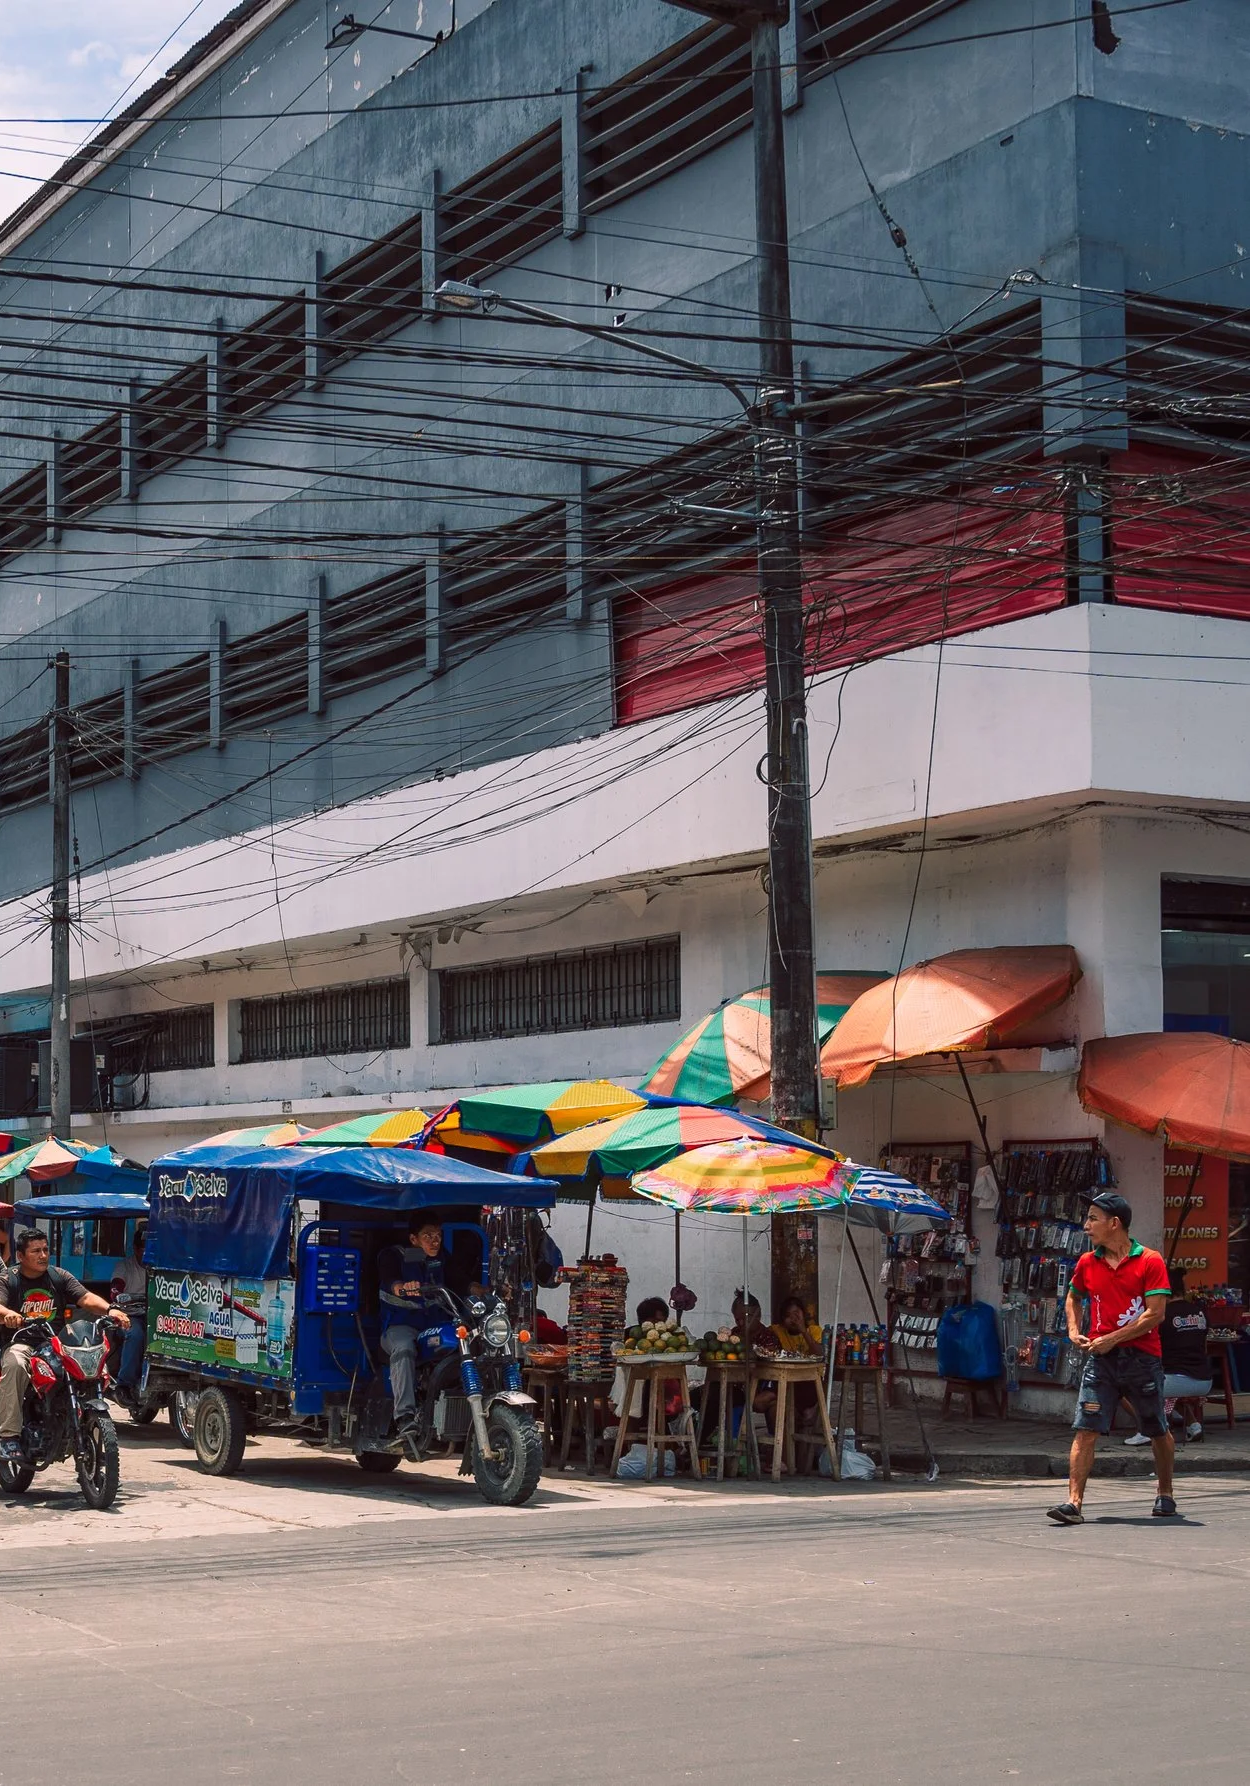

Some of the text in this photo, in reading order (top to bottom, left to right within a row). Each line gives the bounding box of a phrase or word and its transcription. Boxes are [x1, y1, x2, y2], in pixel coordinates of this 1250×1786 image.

[159, 1173, 227, 1197] Yacu Selva
[155, 1275, 180, 1299] Yacu
[193, 1280, 224, 1306] Selva
[209, 1311, 230, 1327] AGUA
[213, 1326, 234, 1338] DE MESA
